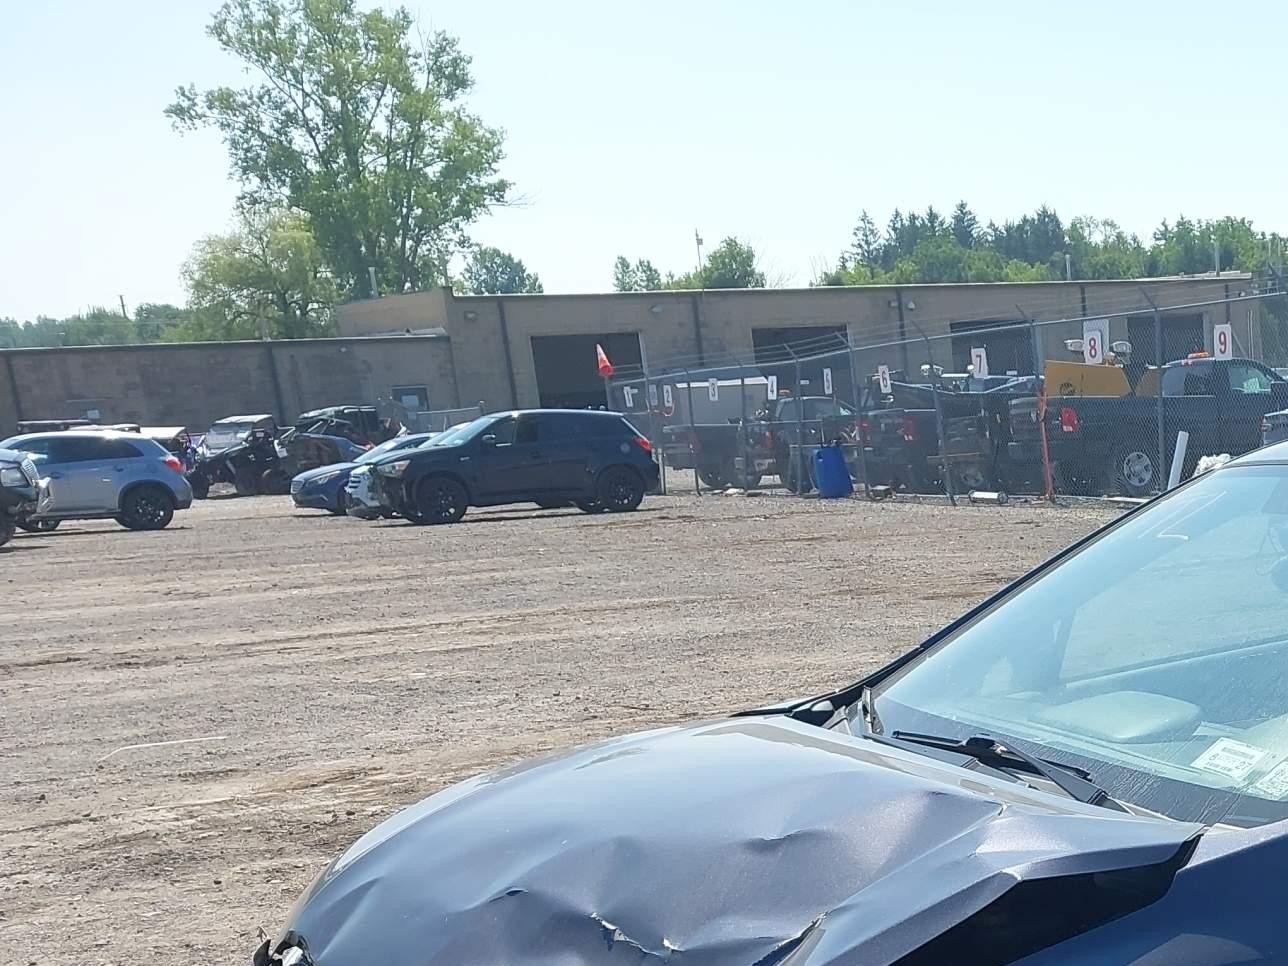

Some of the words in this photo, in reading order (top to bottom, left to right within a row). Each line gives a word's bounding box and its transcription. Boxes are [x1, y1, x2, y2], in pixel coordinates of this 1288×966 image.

[1088, 336, 1097, 358] 8
[1218, 331, 1227, 354] 9
[975, 354, 982, 373] 7
[710, 382, 717, 397] 3
[769, 380, 775, 395] 4
[881, 372, 888, 390] 6
